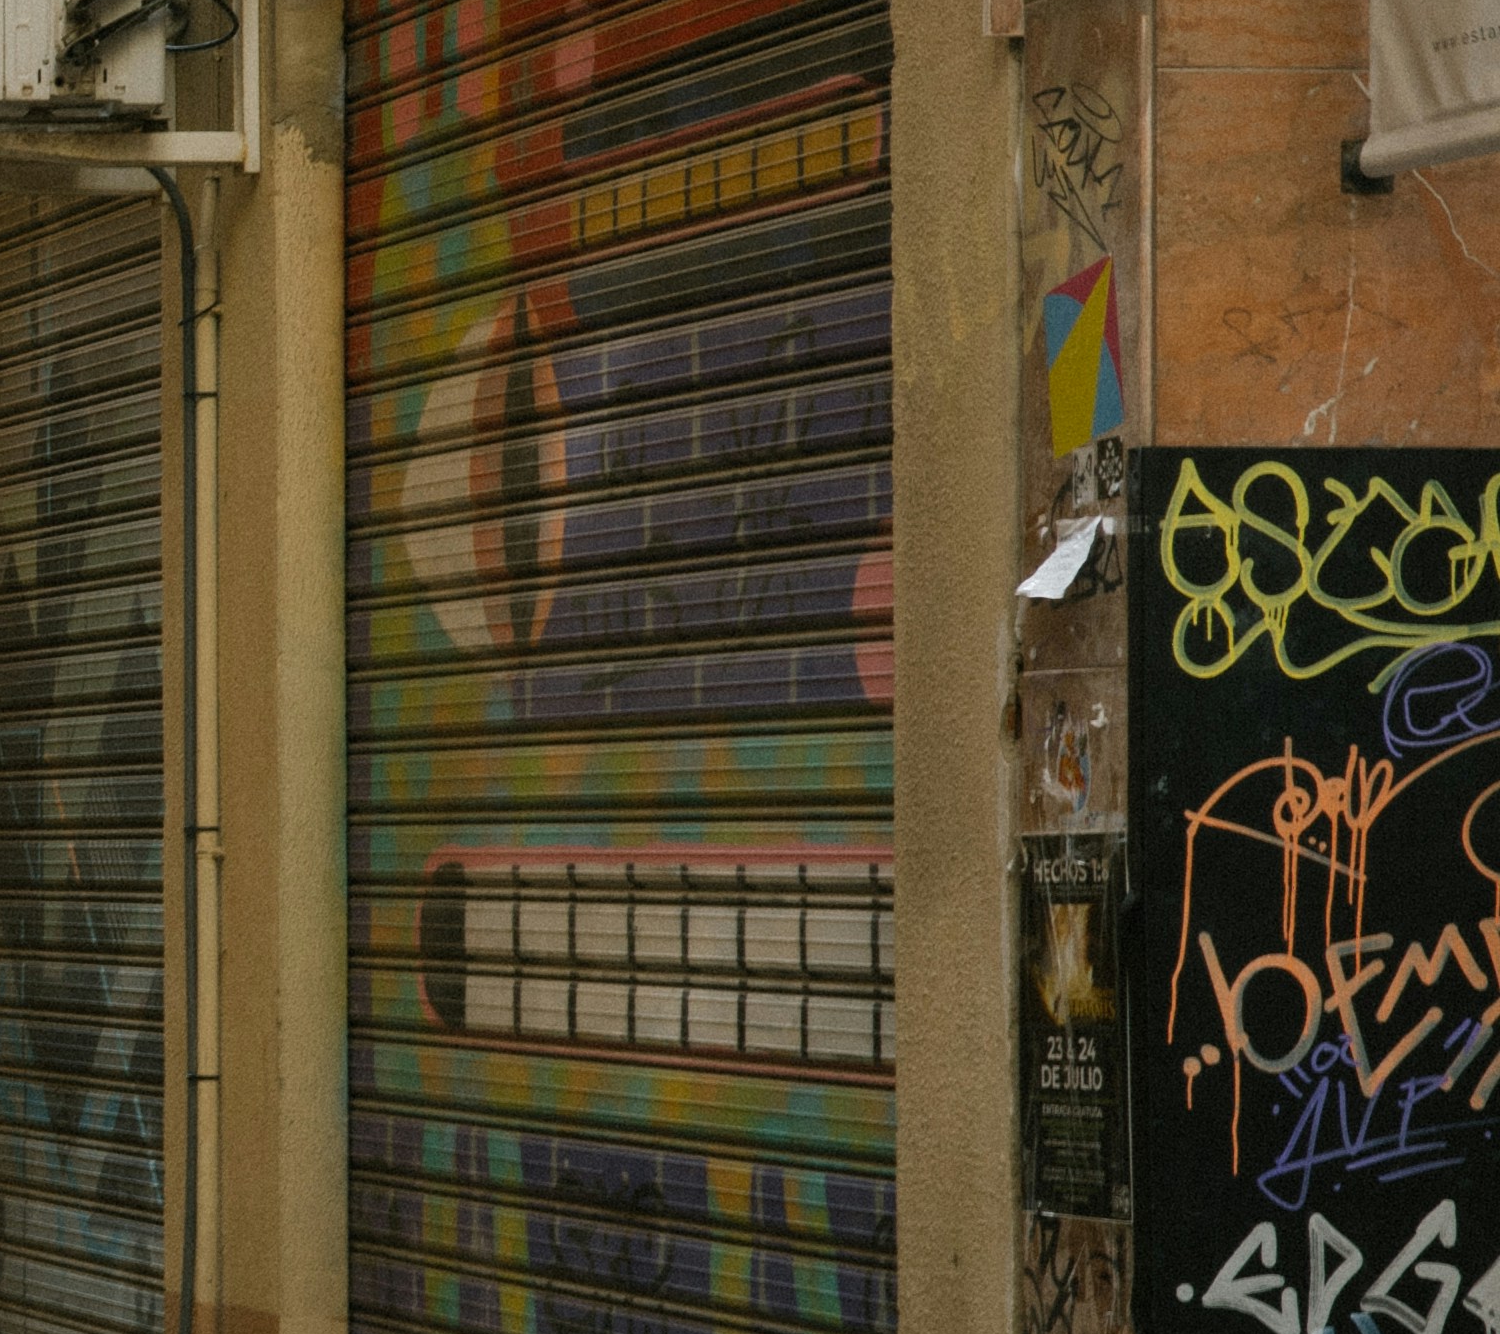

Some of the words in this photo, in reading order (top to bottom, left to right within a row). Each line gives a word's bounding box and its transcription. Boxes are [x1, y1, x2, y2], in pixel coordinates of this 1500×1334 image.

[1033, 857, 1087, 884] HECHOS
[1047, 1036, 1063, 1060] 23
[1078, 1037, 1096, 1062] 24
[1041, 1065, 1060, 1089] DE
[1064, 1067, 1103, 1091] JULIO
